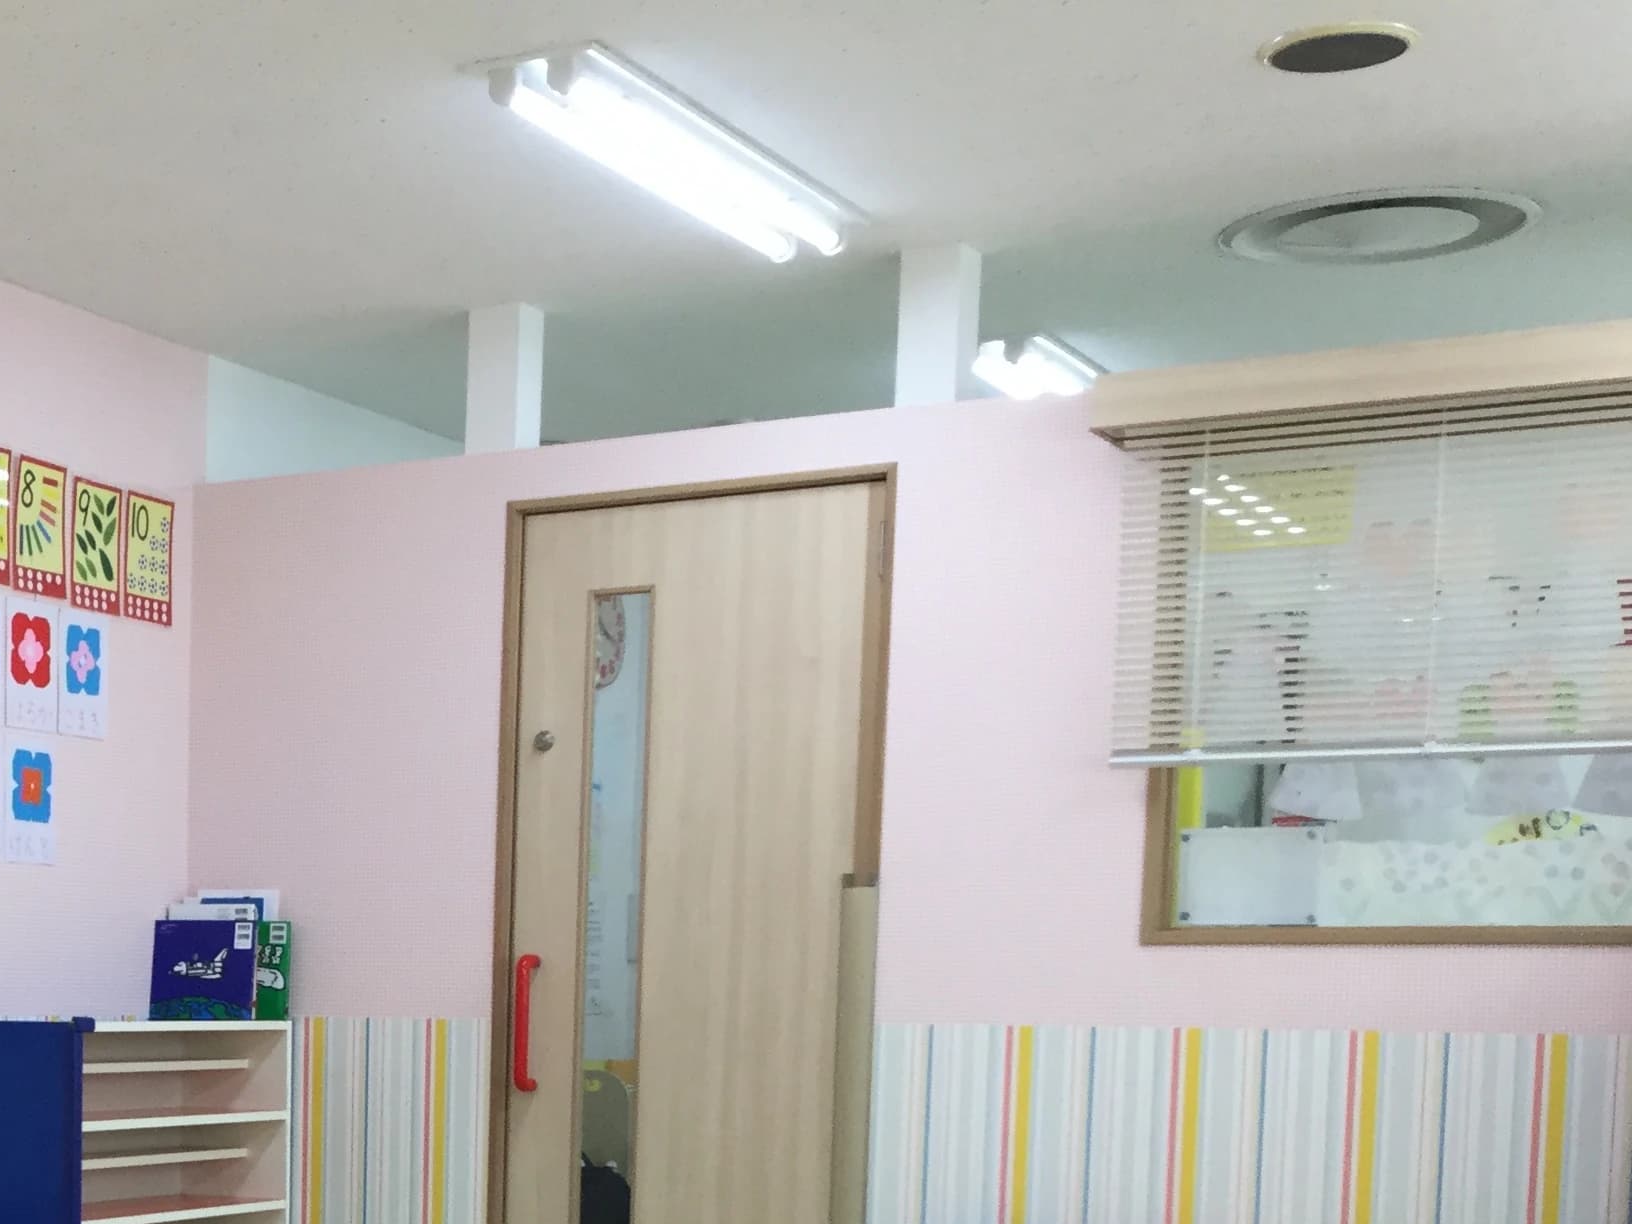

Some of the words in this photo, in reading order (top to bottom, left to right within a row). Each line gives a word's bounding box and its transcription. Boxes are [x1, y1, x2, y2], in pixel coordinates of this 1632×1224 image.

[20, 469, 37, 508] 8
[78, 489, 92, 527] 9
[131, 502, 149, 541] 10
